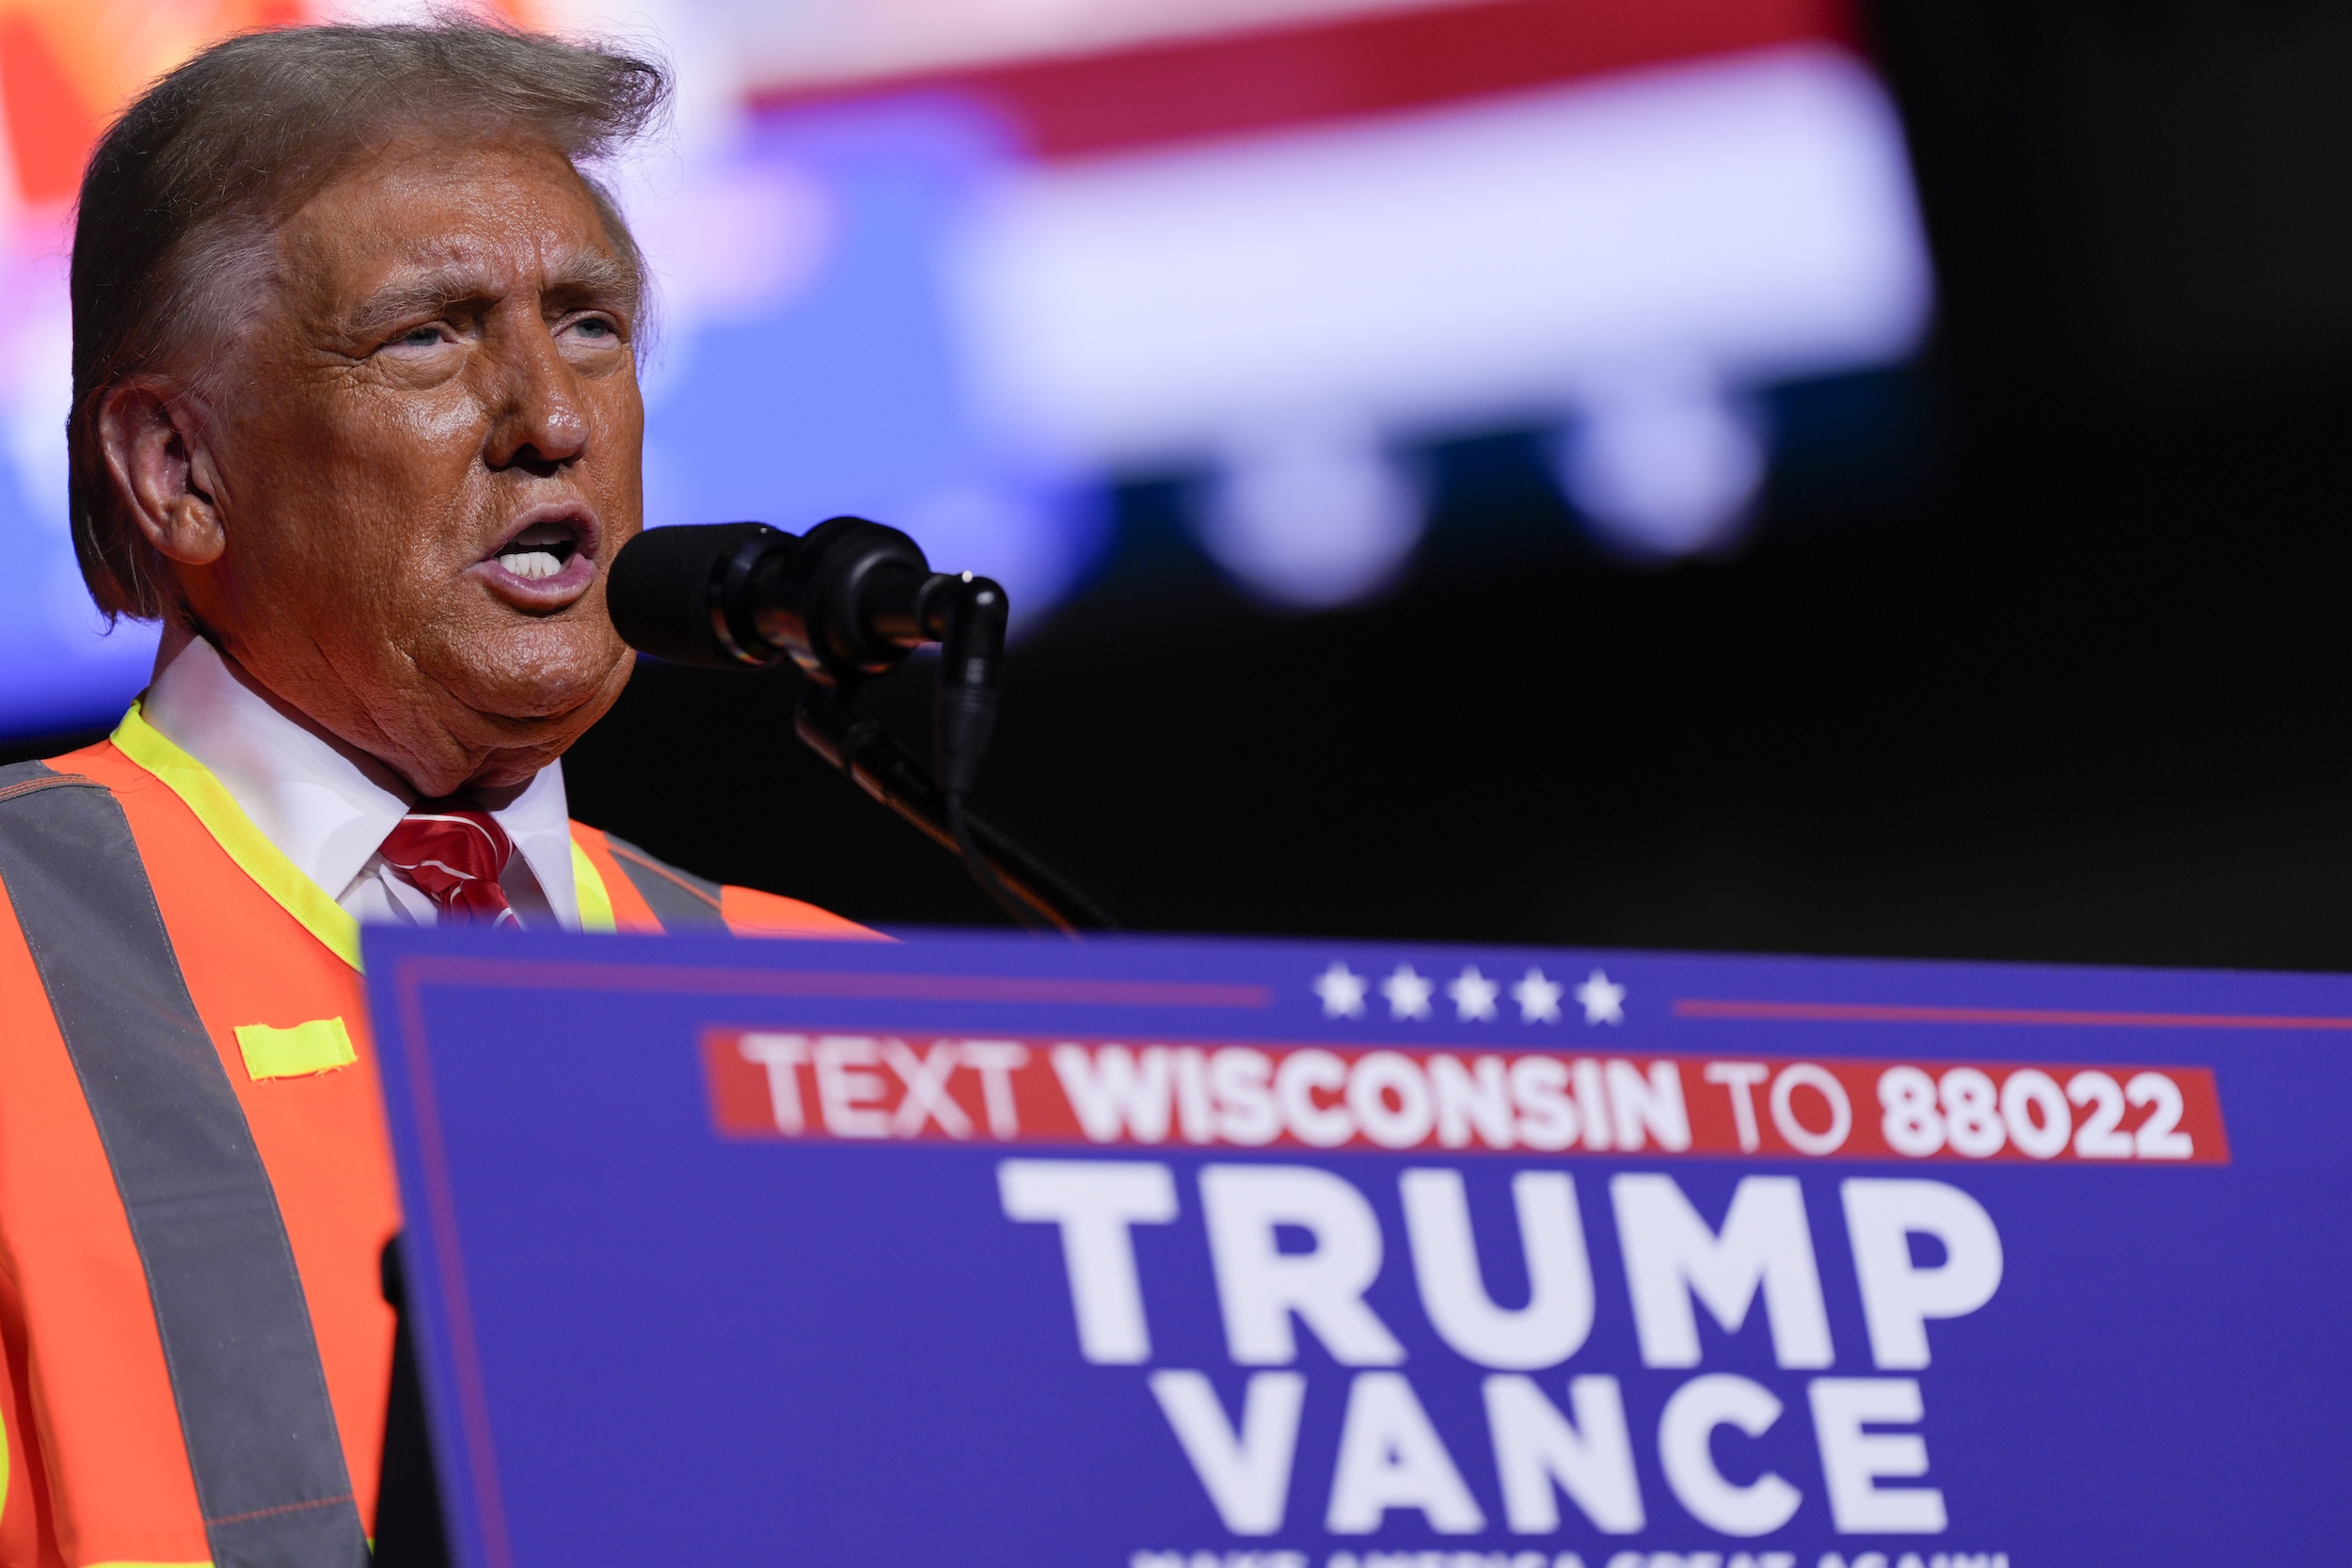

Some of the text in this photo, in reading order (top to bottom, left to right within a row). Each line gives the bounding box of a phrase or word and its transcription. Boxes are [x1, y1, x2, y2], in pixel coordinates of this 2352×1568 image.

[739, 1033, 2195, 1160] TEXT WISCONSIN TO 88022
[996, 1158, 2005, 1372] TRUMP
[1148, 1370, 1948, 1538] VANCE
